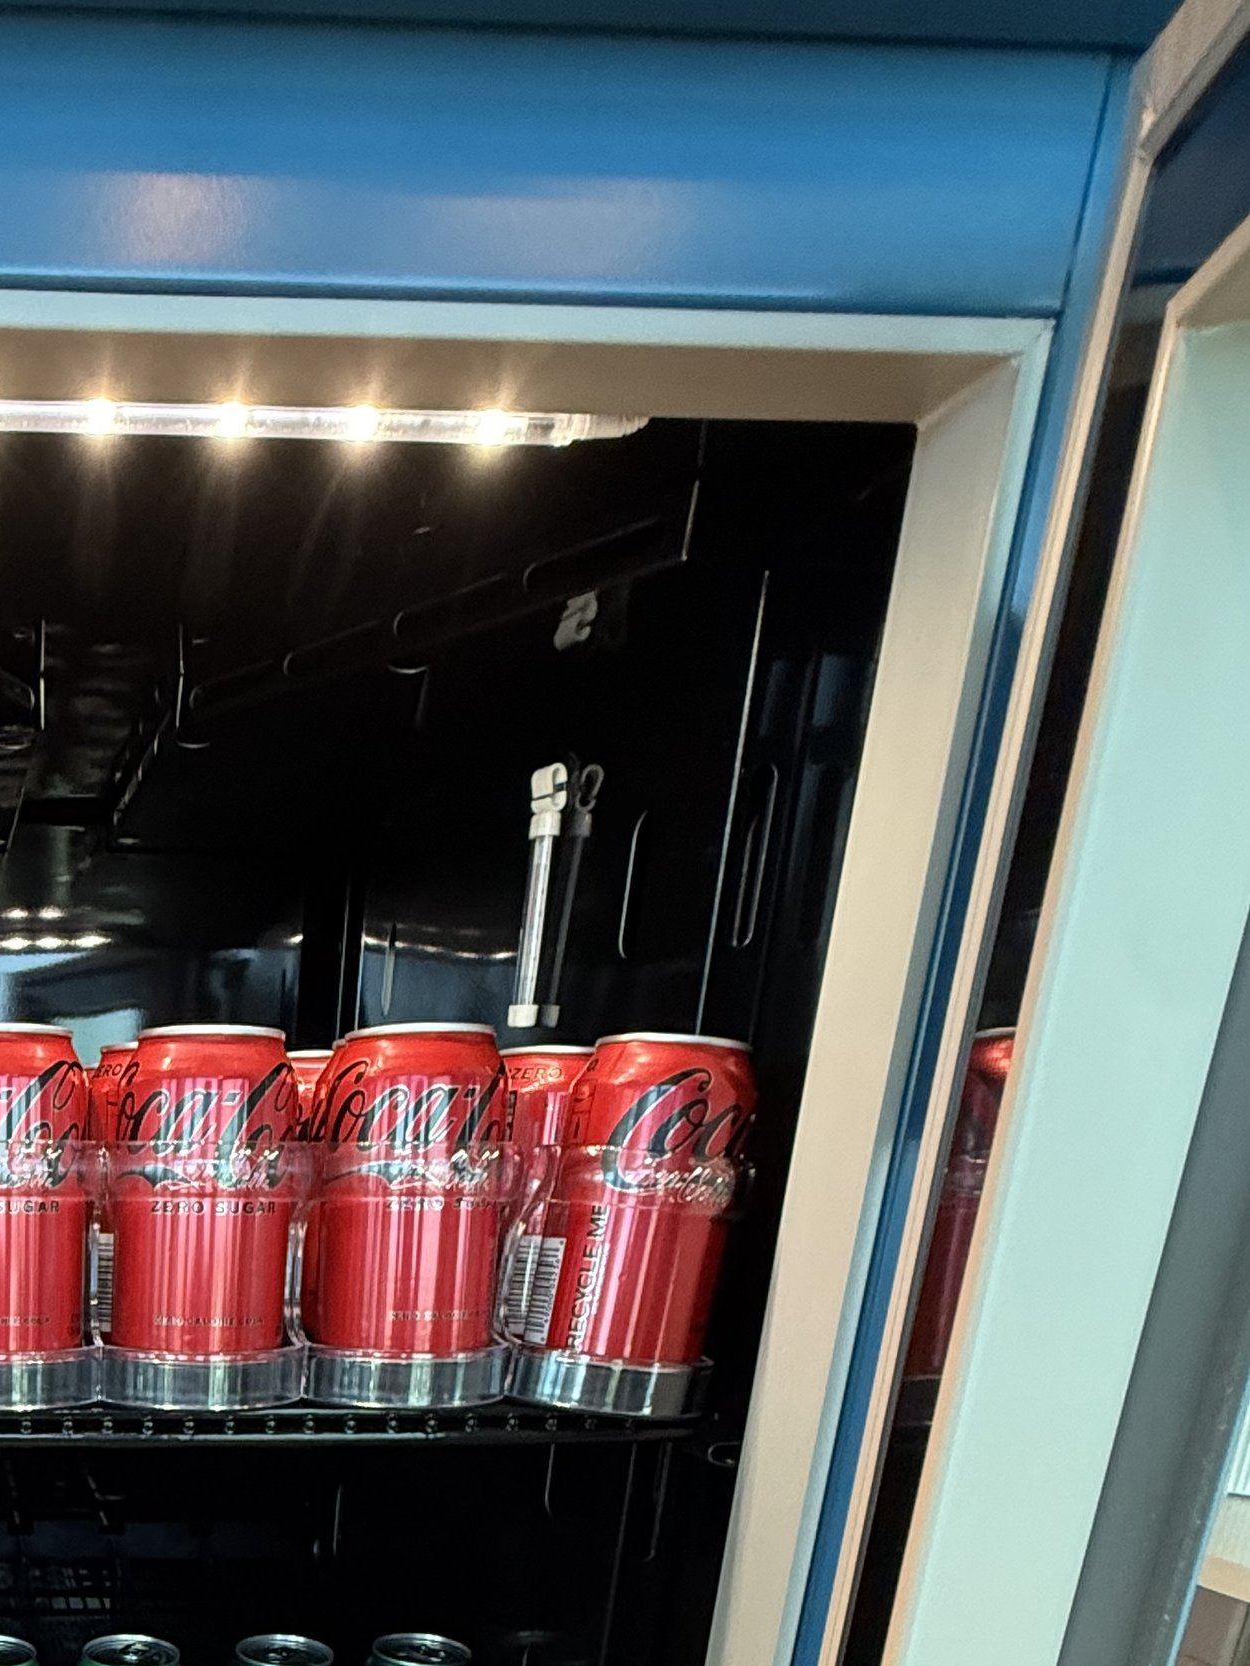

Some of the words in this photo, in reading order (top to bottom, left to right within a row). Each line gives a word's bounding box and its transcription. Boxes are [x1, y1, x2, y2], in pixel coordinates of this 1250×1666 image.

[511, 1066, 563, 1081] ZERO
[151, 1200, 205, 1214] ZERO
[214, 1200, 276, 1214] SUGAR
[567, 1244, 601, 1351] RECYCLE
[592, 1204, 610, 1242] ME
